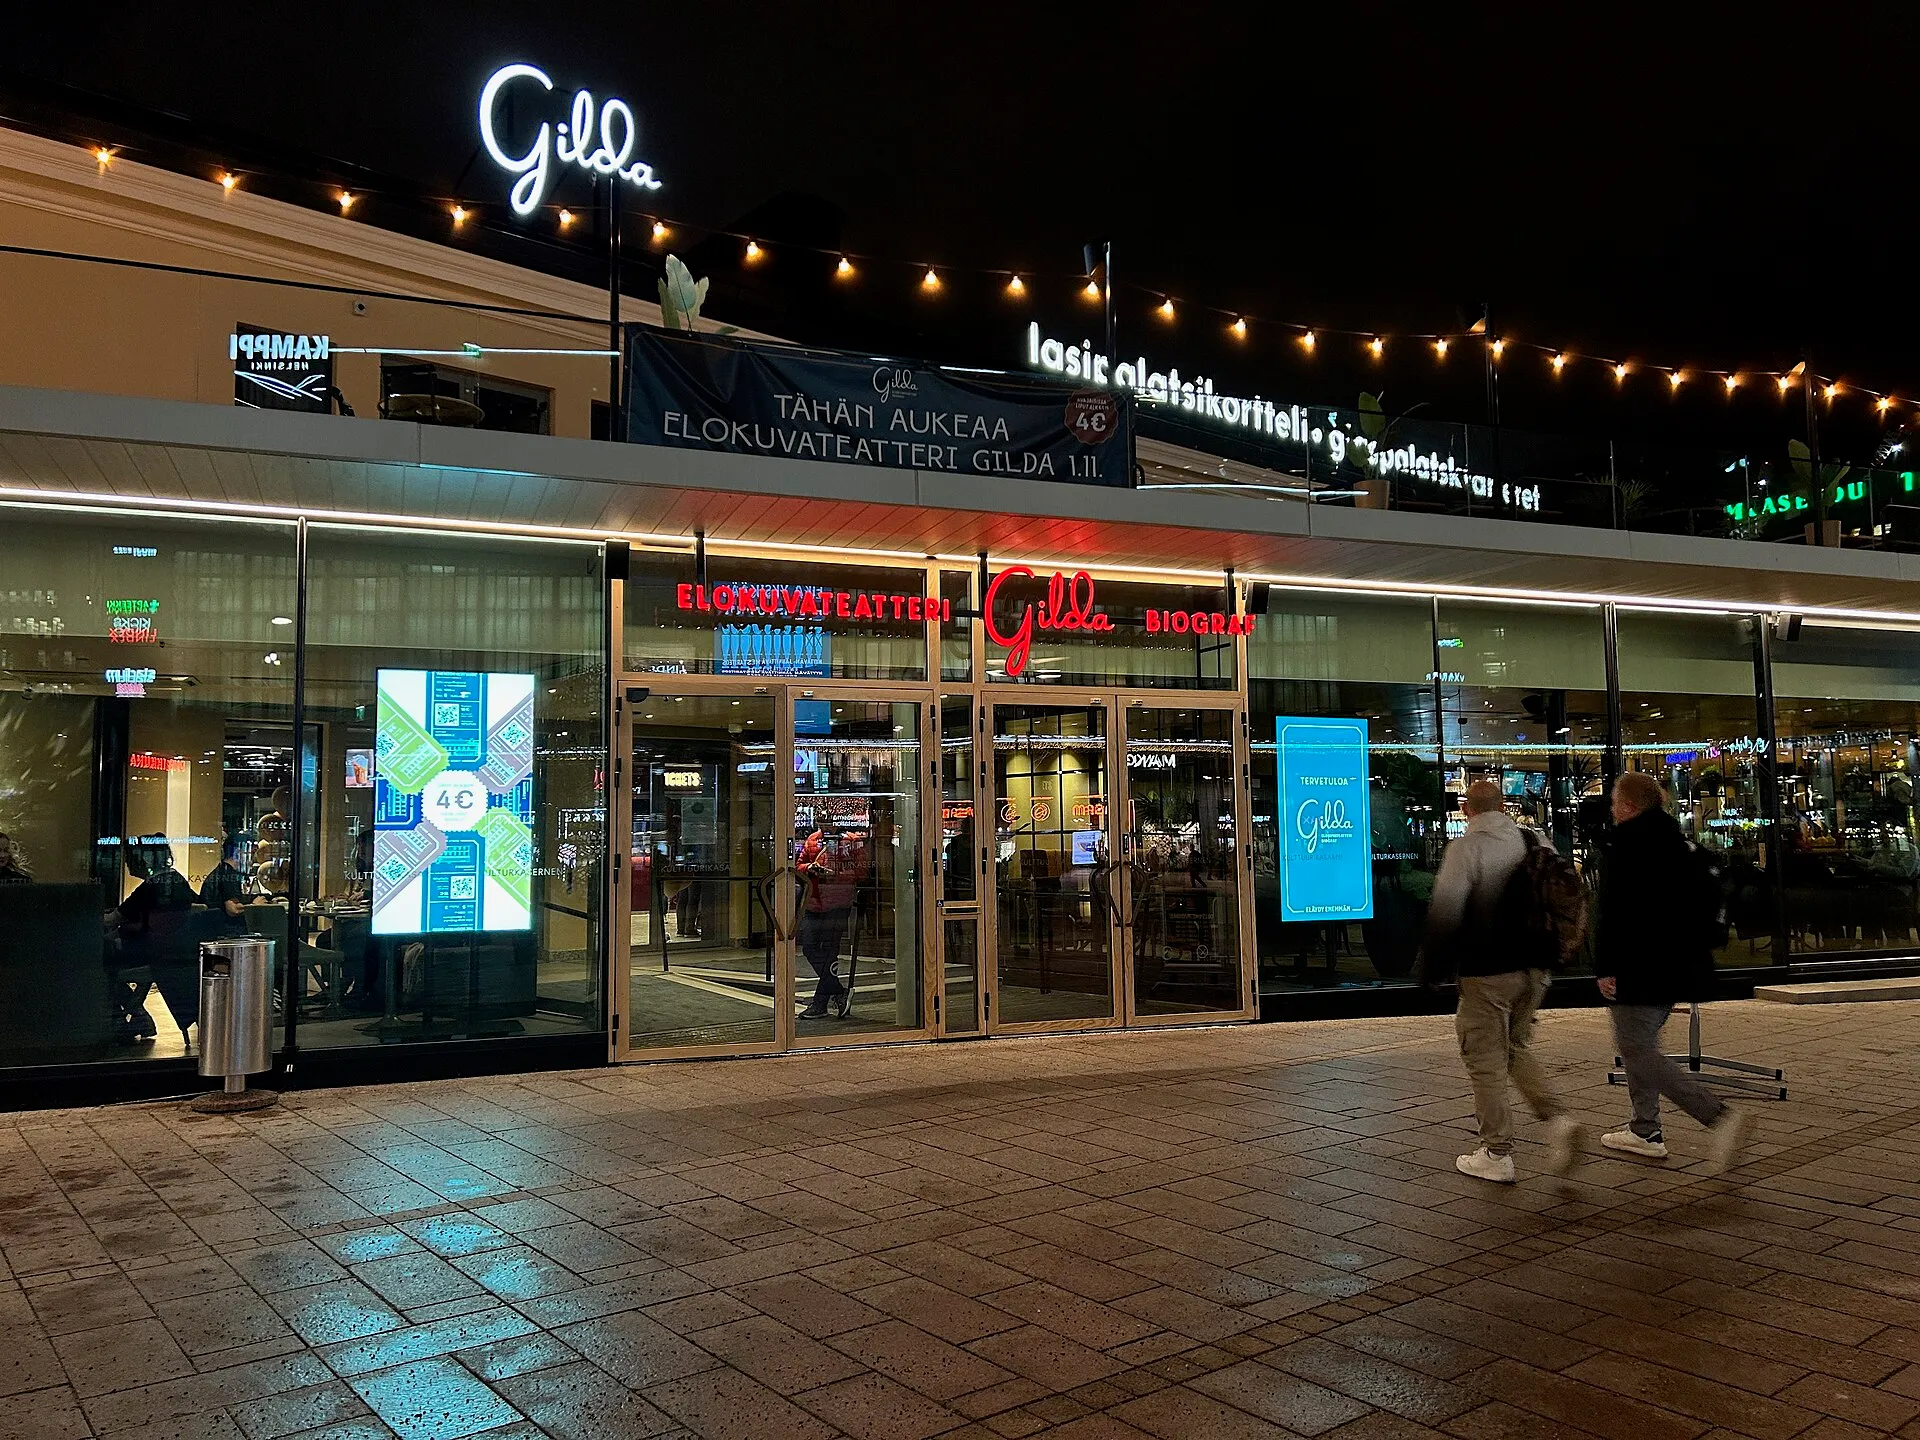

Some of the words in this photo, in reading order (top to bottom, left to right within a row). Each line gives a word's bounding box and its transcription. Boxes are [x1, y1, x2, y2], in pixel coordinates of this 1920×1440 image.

[479, 63, 663, 215] Gilda
[872, 366, 919, 404] Gilda
[773, 392, 875, 429] TÄHÄN
[890, 408, 1009, 442] AUKEAA
[1076, 412, 1106, 432] 4€
[664, 410, 958, 471] ELOKUVATEATTERI
[972, 448, 1055, 476] GILDA
[1069, 454, 1104, 479] 1.11.
[676, 583, 951, 622] ELOKUVATEATTERI
[984, 565, 1115, 677] Gilda
[1145, 609, 1256, 636] BIOGRAF
[1300, 776, 1349, 786] TERVETULOA
[1296, 798, 1354, 853] Gilda
